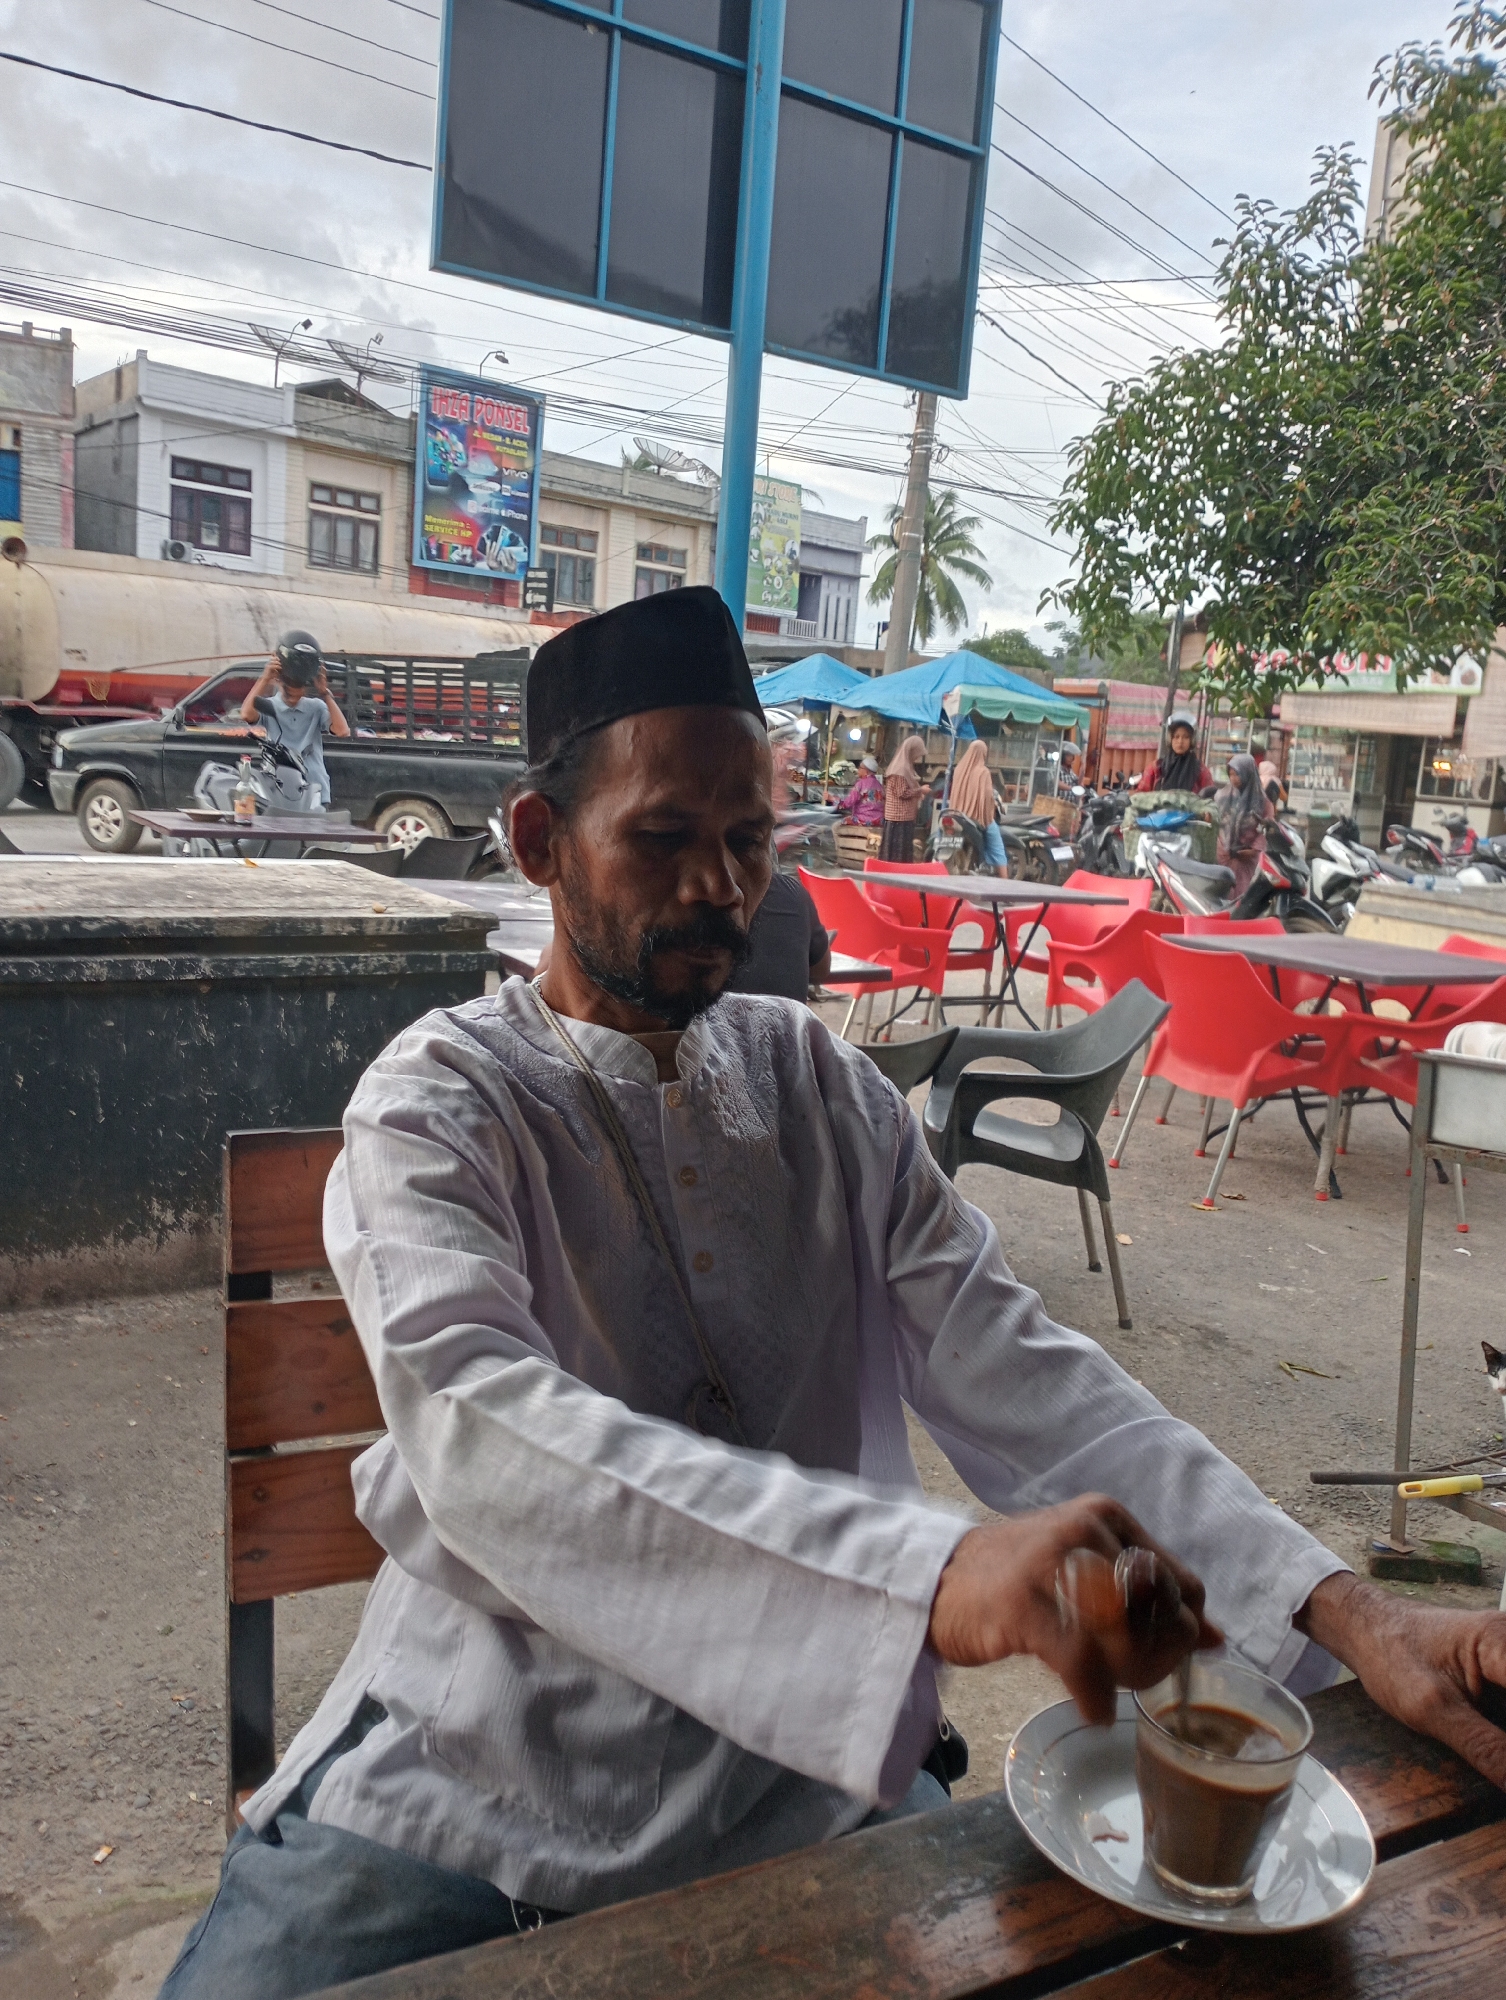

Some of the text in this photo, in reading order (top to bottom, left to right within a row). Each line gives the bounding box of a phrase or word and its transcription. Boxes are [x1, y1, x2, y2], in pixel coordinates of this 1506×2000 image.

[431, 386, 530, 435] IHZA PONSEL
[424, 524, 459, 536] SERVICE
